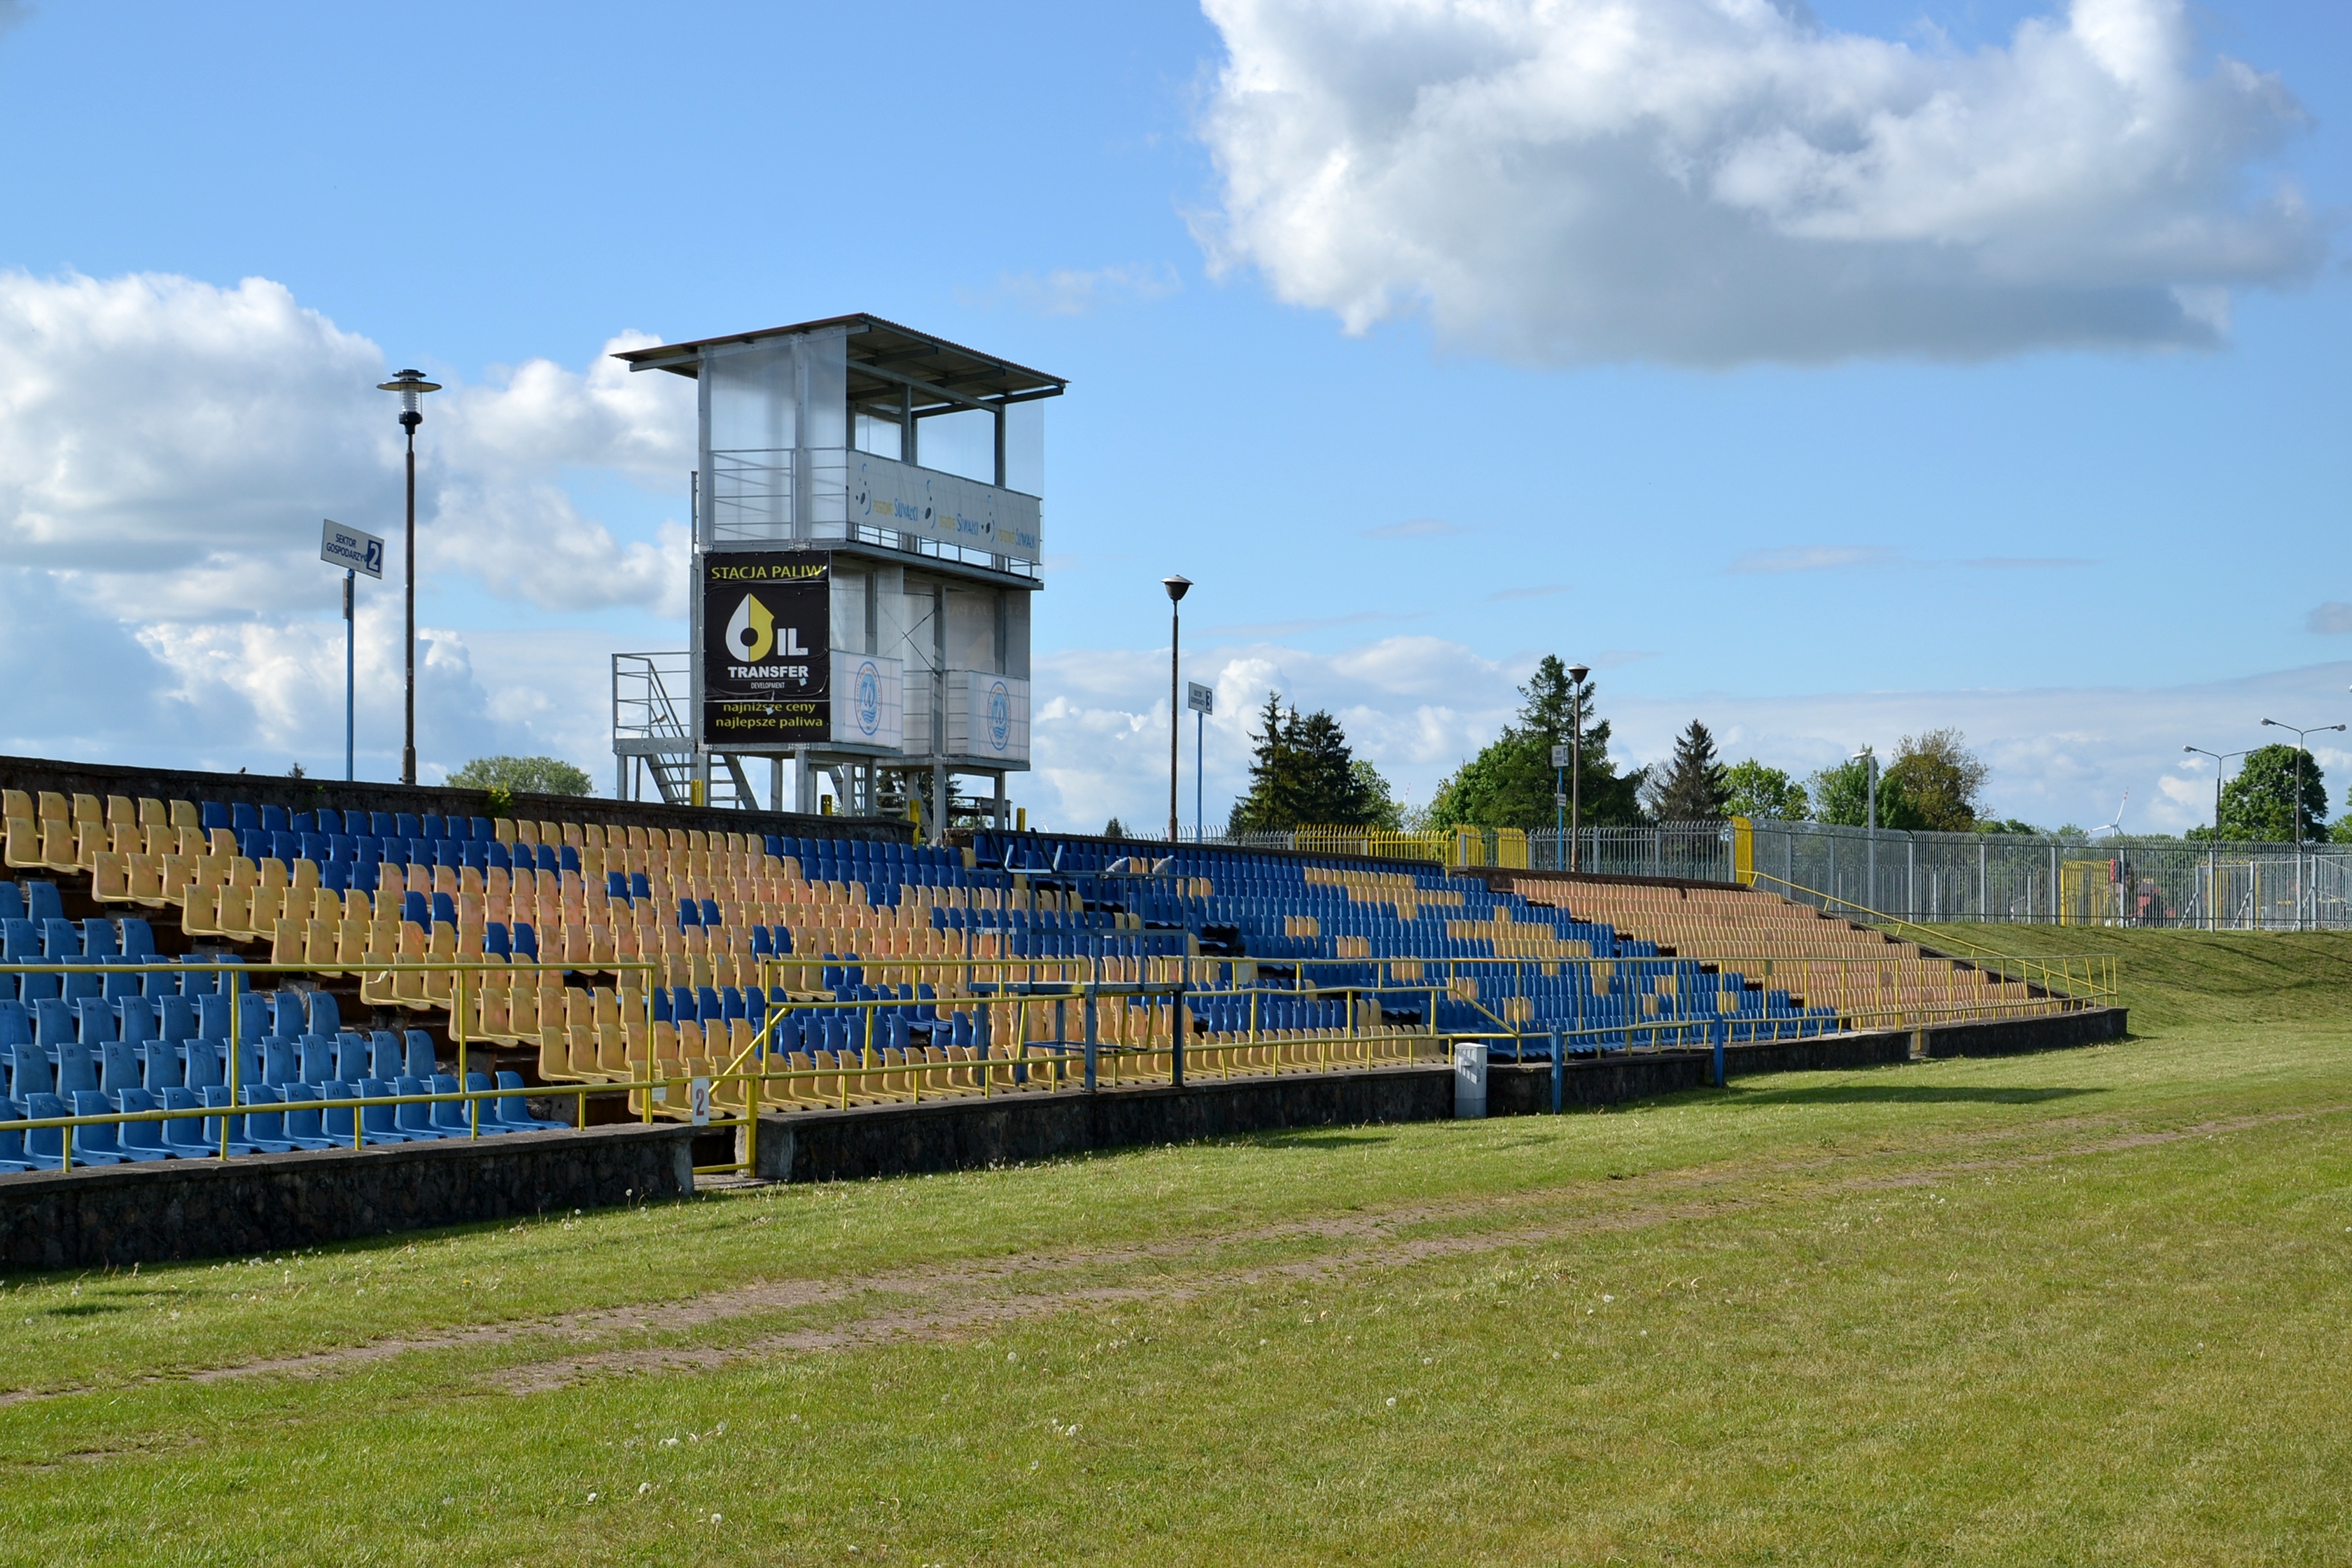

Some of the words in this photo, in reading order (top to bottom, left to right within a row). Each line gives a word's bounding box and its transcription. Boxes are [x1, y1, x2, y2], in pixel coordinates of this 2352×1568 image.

[336, 533, 356, 547] SEKTOR
[326, 542, 364, 562] GOSPODARZY
[369, 542, 379, 570] 2
[711, 566, 767, 580] STACJA
[772, 565, 823, 578] PALIW
[728, 666, 808, 678] TRANSFER
[785, 703, 816, 714] ceny
[1207, 692, 1211, 710] 3
[716, 717, 776, 729] najlepsze
[780, 716, 822, 729] paliwa
[696, 1088, 704, 1116] 2
